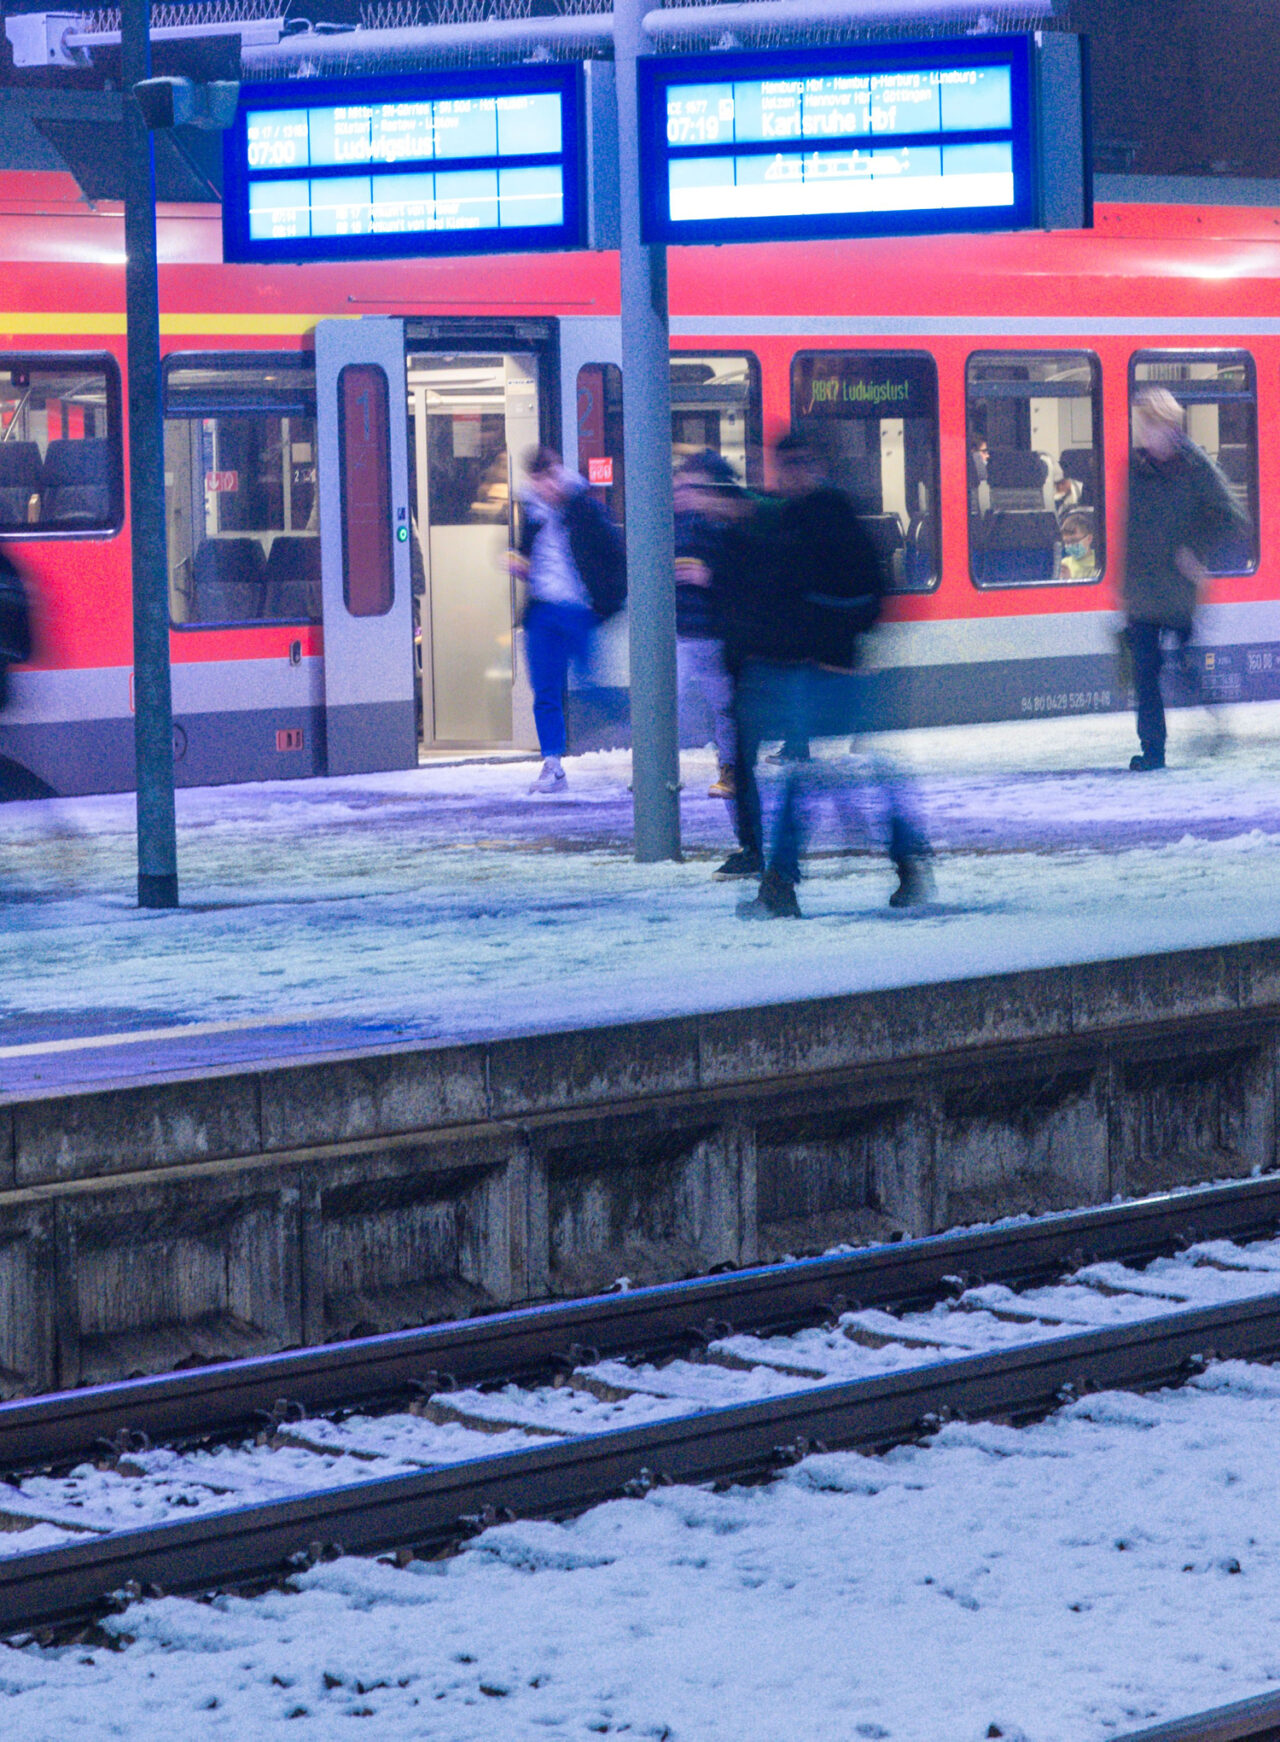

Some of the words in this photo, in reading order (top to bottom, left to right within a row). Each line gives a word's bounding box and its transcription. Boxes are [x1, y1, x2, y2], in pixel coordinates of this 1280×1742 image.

[667, 115, 720, 142] 07:19
[761, 107, 857, 138] Karlsruhe
[862, 105, 897, 132] Hbf
[248, 140, 296, 165] 07:00
[334, 131, 442, 163] Ludwigslust
[842, 378, 909, 404] Ludwigslust
